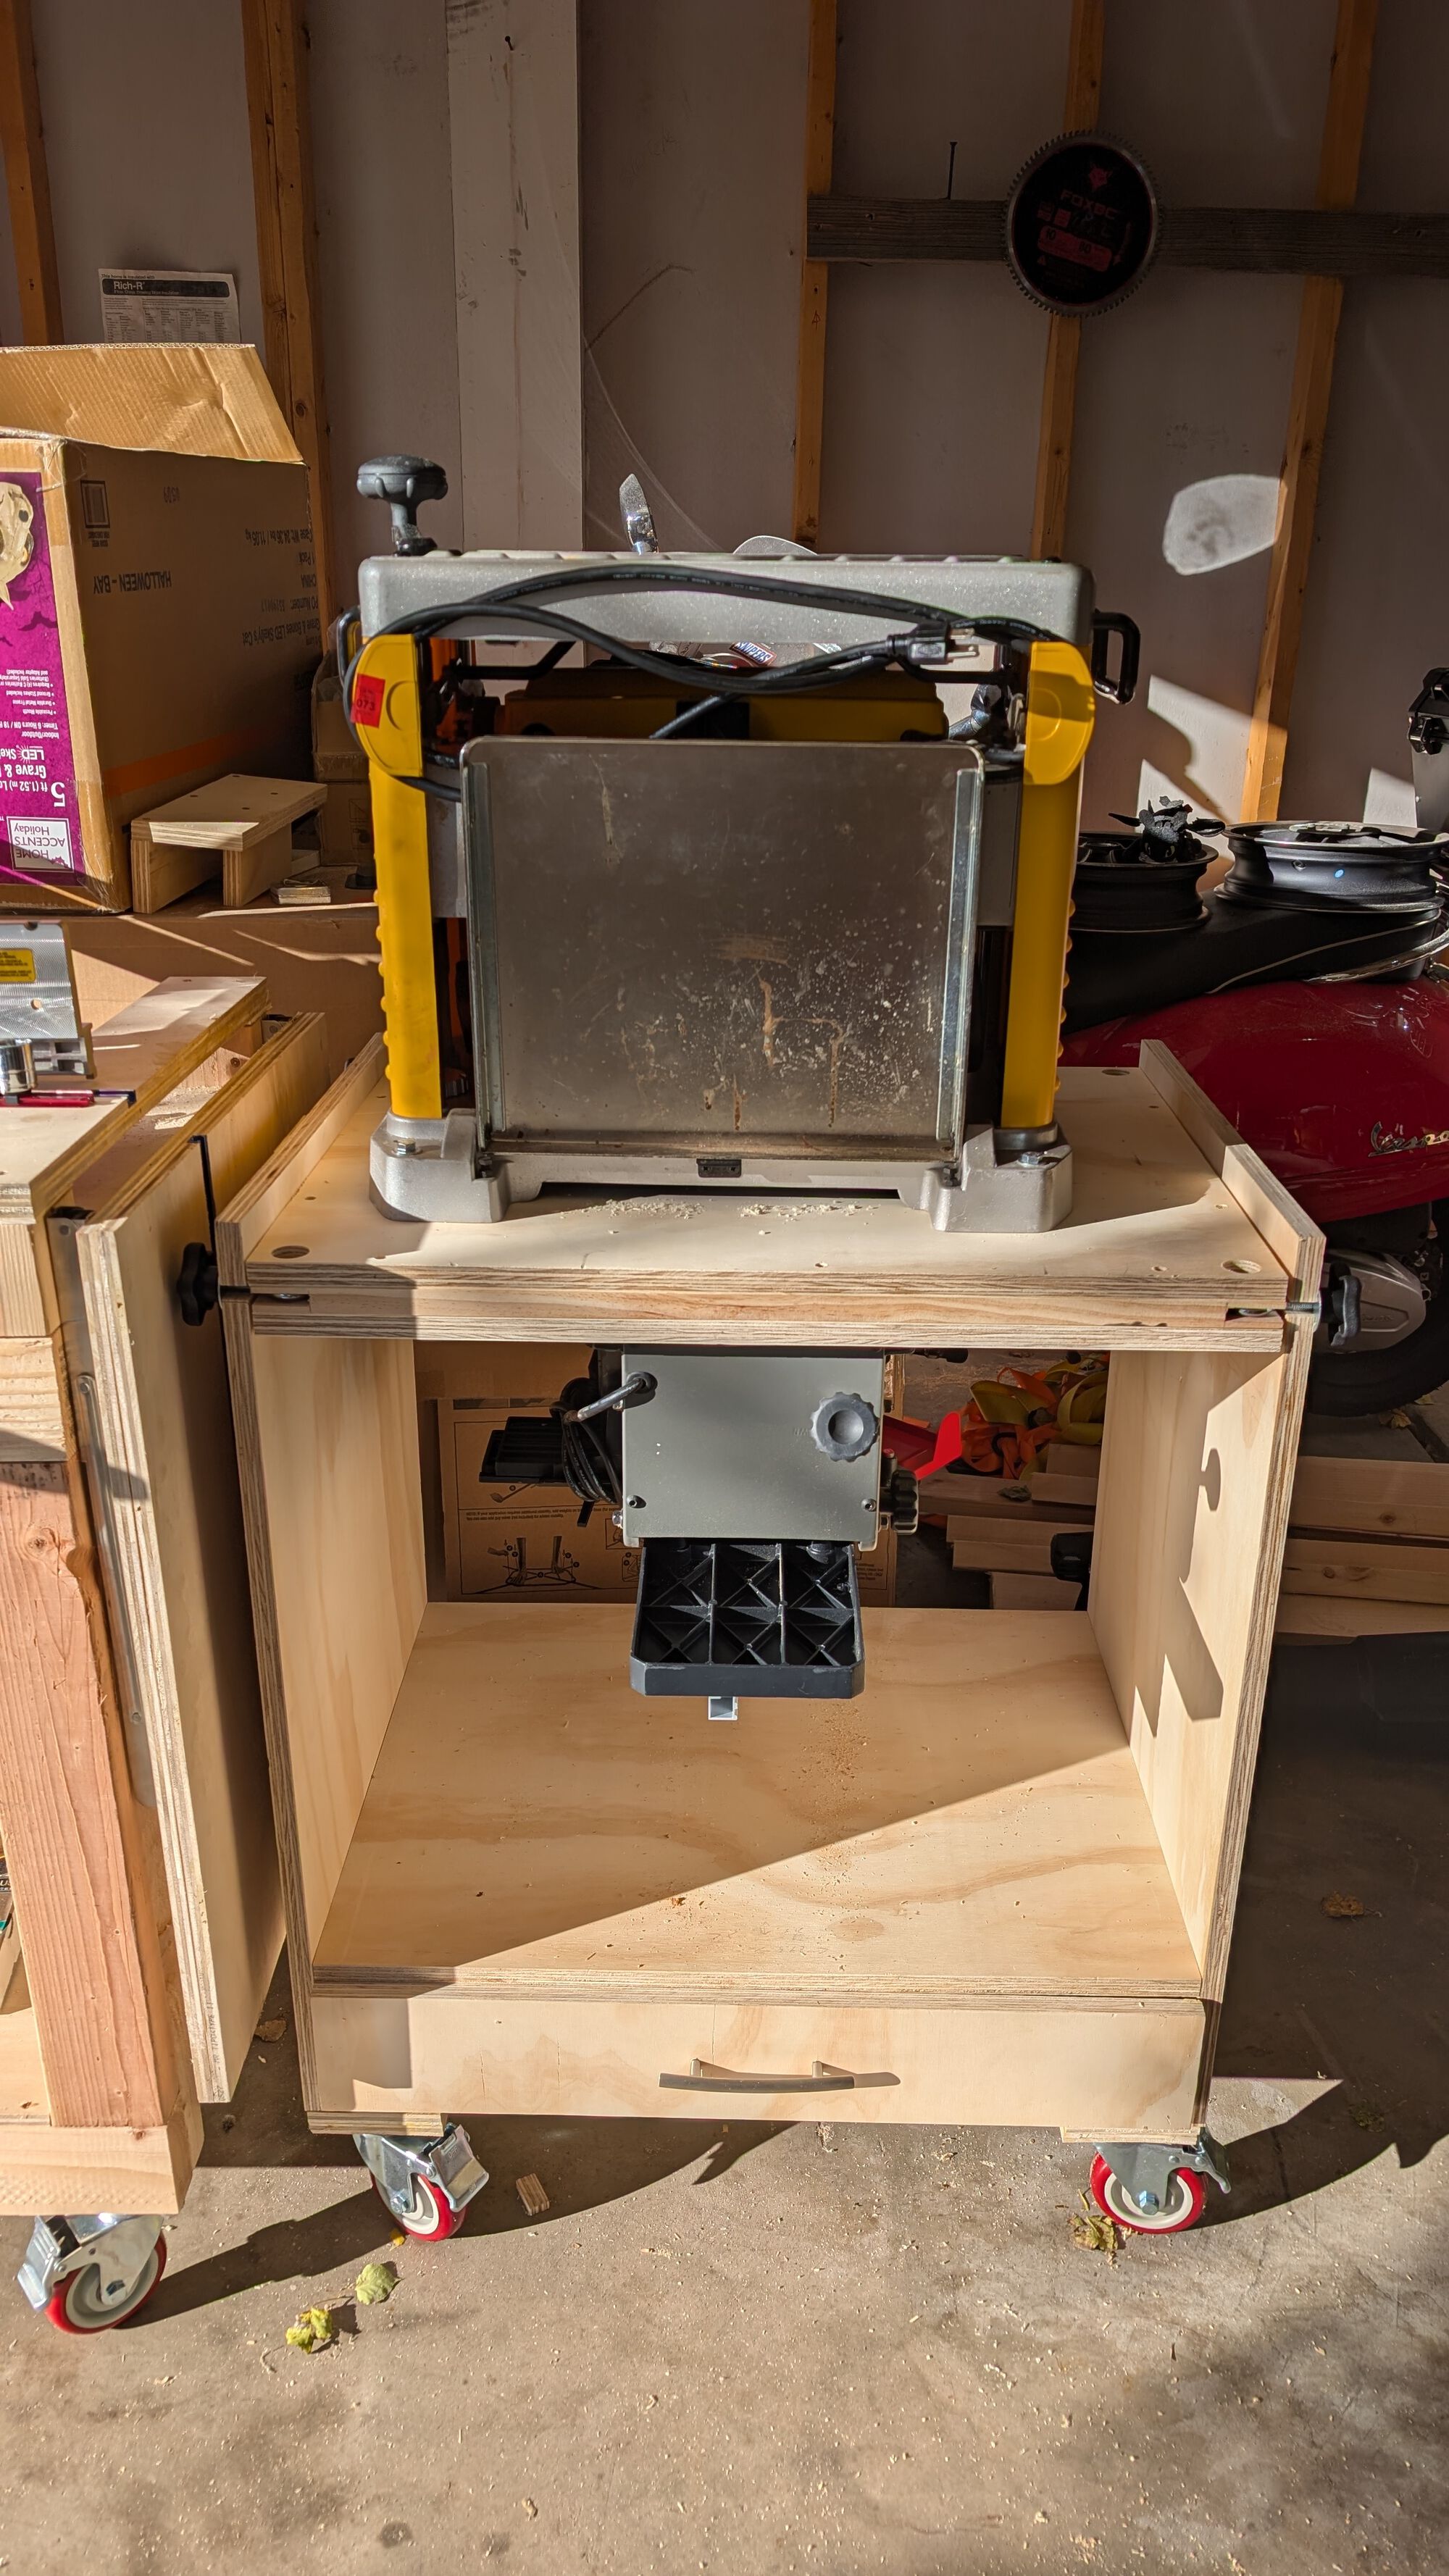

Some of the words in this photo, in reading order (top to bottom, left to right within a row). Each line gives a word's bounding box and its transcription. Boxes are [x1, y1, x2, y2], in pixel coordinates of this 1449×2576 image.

[299, 551, 311, 565] Pack
[93, 575, 111, 594] BAY
[118, 570, 172, 591] HALLOWEEN
[301, 574, 317, 588] CHINA
[242, 632, 253, 646] Cat
[275, 625, 285, 640] LED
[21, 749, 44, 760] LED
[4, 764, 12, 777] &
[15, 764, 46, 779] Grave
[9, 781, 18, 791] m)
[20, 780, 39, 792] (1.52
[40, 781, 47, 791] ft
[51, 781, 66, 807] 5
[14, 823, 49, 835] Holiday
[14, 836, 65, 847] ACCENTS
[16, 848, 49, 859] HOME
[448, 2146, 458, 2159] OFF
